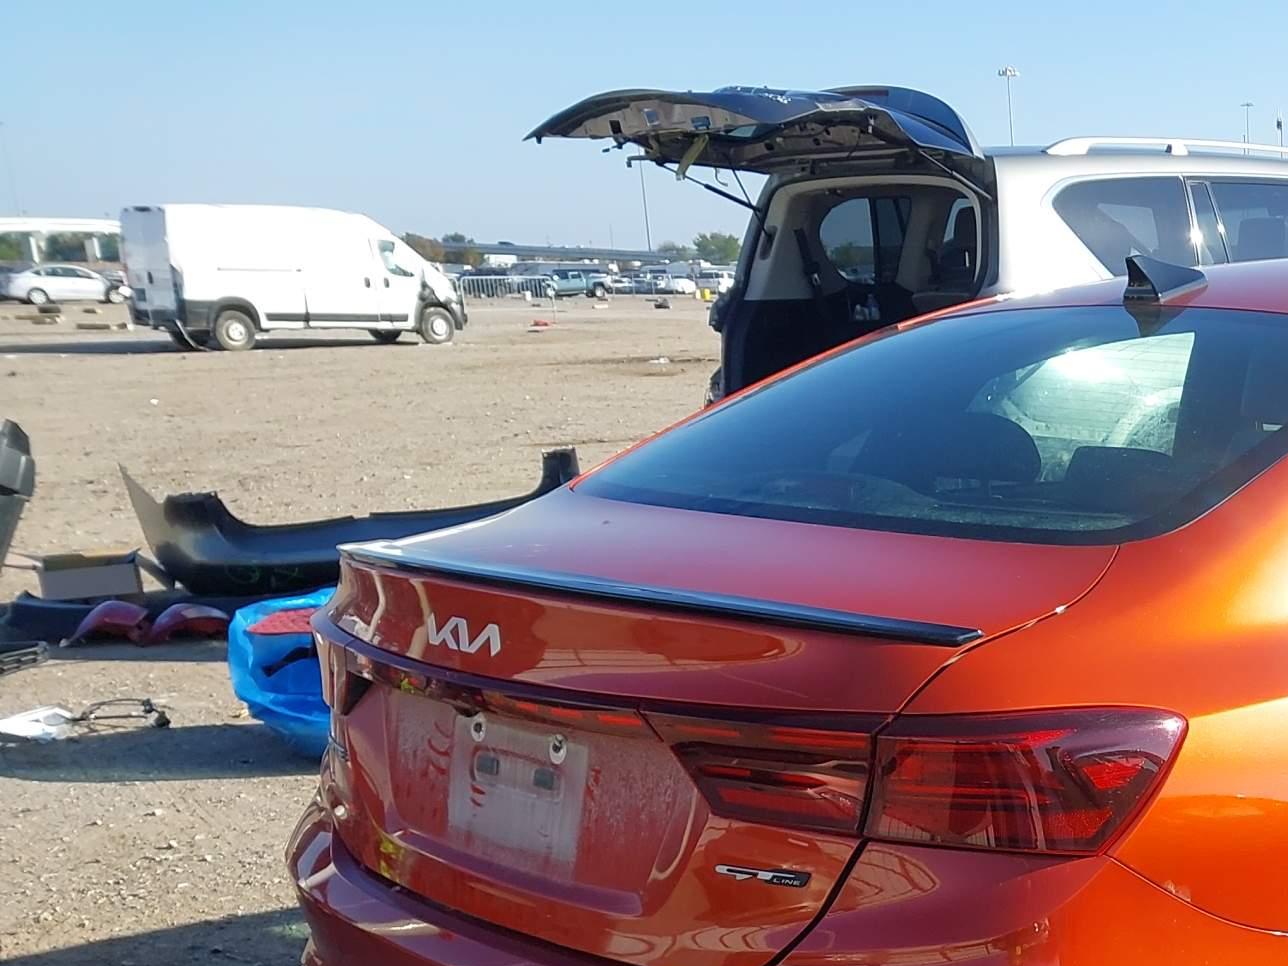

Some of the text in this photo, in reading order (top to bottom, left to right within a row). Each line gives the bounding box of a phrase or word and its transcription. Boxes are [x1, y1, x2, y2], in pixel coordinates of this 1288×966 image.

[427, 612, 502, 657] KIA
[715, 864, 796, 881] GT
[772, 877, 801, 887] LINE
